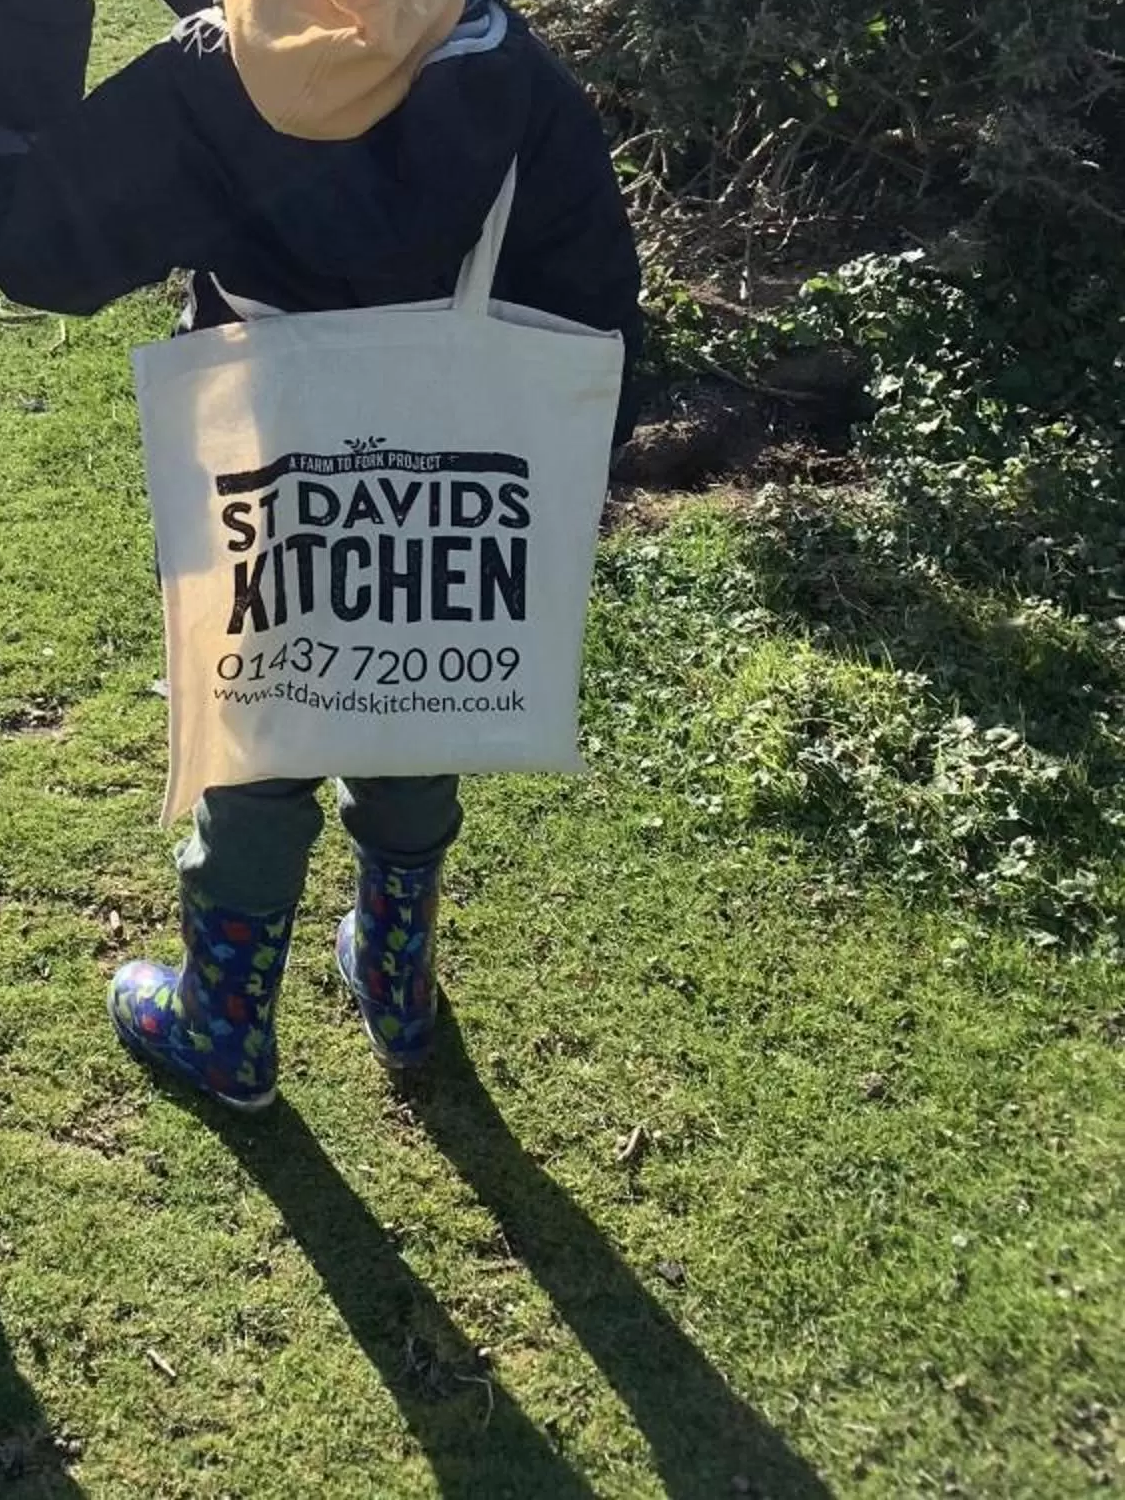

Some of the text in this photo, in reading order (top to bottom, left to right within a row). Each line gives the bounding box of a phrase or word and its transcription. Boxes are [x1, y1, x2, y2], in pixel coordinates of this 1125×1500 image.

[288, 453, 442, 473] A FARM TO FORK PROJECT
[222, 478, 531, 552] ST DAVIDS
[227, 534, 527, 635] KITCHEN
[217, 637, 521, 684] 01437 720 009
[214, 681, 525, 714] www.stdavidskitchen.co.uk
